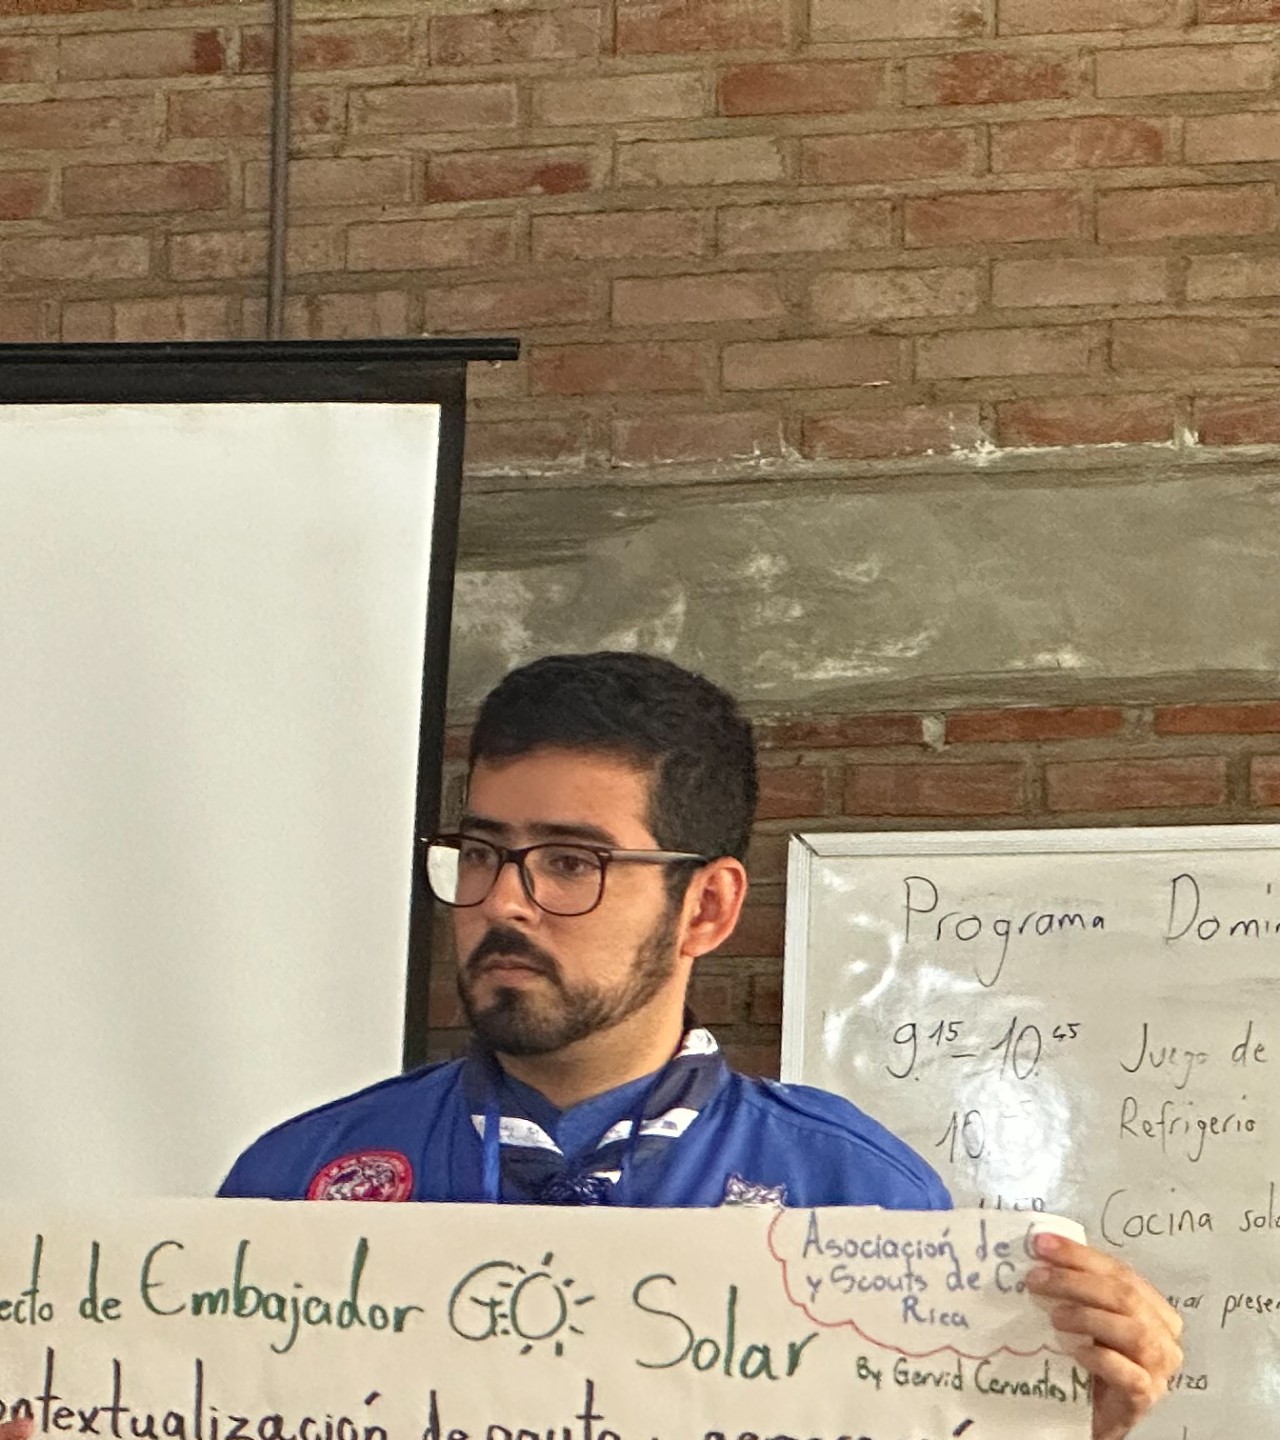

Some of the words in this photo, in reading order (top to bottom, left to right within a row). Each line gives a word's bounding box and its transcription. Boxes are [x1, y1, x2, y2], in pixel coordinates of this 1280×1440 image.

[903, 875, 1105, 988] Programa
[1231, 1020, 1267, 1065] de
[1119, 1095, 1257, 1163] Refrigerio
[803, 1208, 955, 1260] Asociación
[975, 1218, 1011, 1262] de
[1101, 1187, 1214, 1248] Cocina
[806, 1275, 822, 1303] y
[830, 1260, 928, 1294] Scouts
[946, 1258, 981, 1292] de
[79, 1242, 122, 1322] de
[140, 1238, 425, 1354] Embajador
[632, 1273, 820, 1381] Solar
[901, 1294, 970, 1330] Rica
